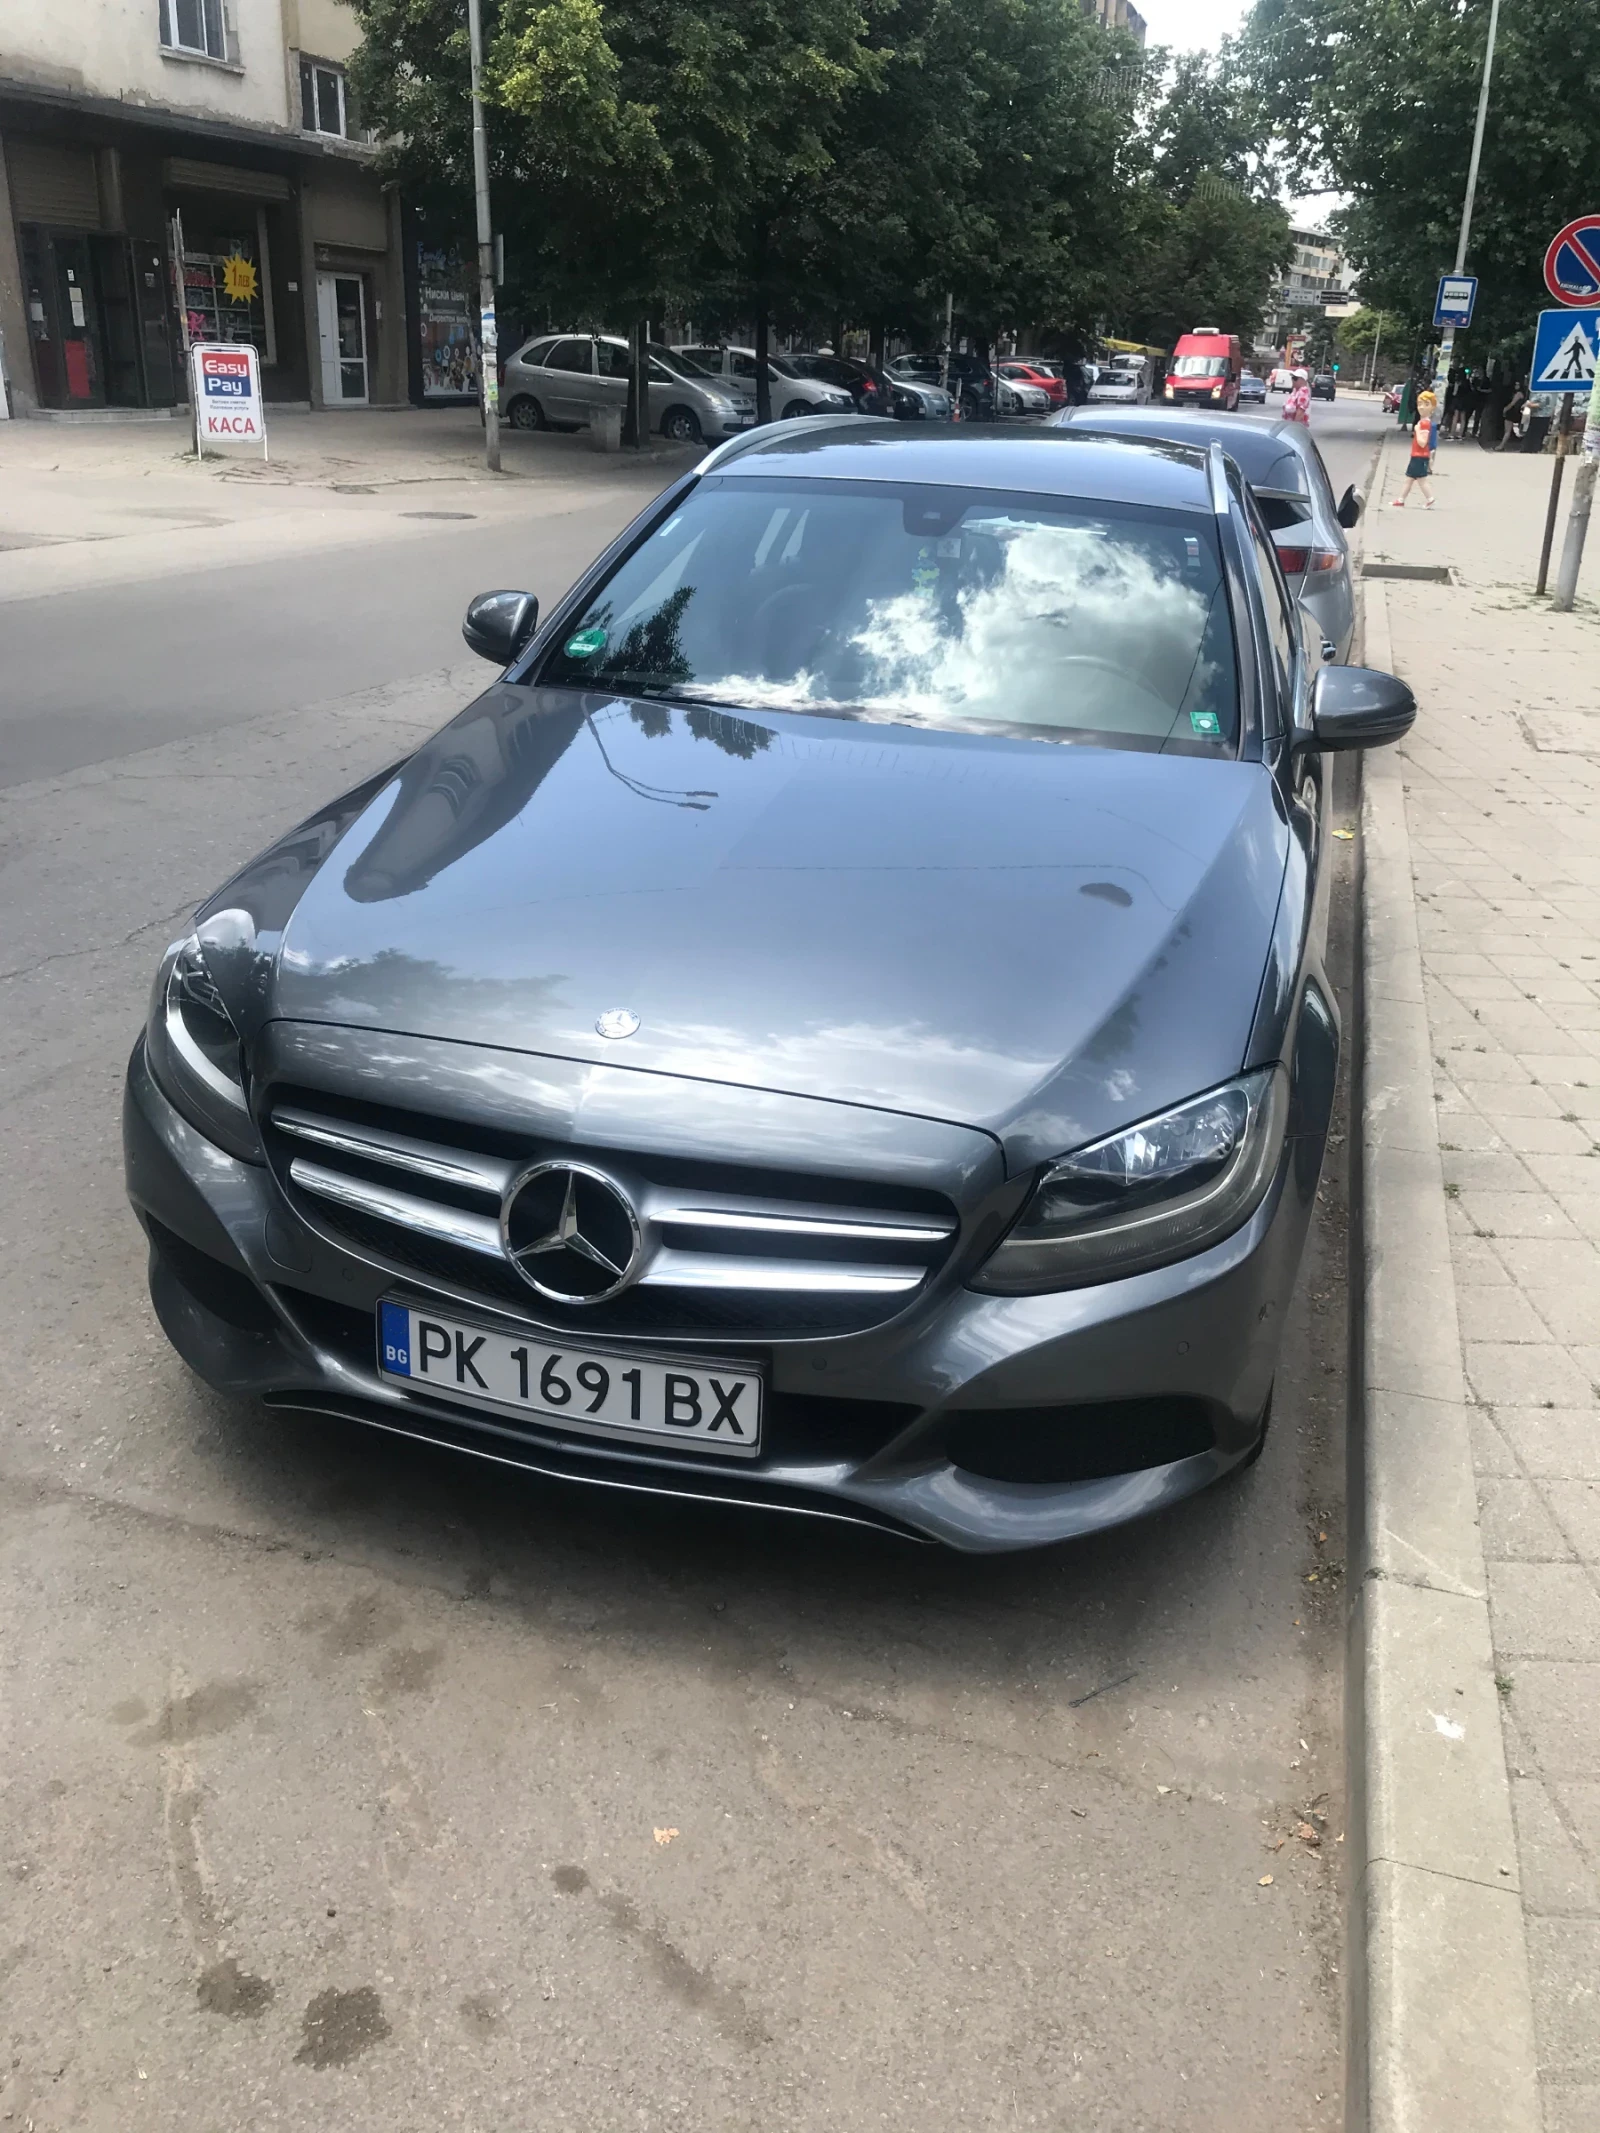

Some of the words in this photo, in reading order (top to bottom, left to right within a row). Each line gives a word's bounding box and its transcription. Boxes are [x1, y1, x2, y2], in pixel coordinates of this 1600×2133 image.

[232, 265, 237, 286] 1
[425, 287, 450, 300] Ниски
[205, 360, 247, 377] Easy
[208, 378, 242, 395] Pay
[208, 416, 256, 434] КАСА
[386, 1344, 407, 1364] BG
[418, 1320, 490, 1390] PK
[510, 1346, 642, 1421] 1691
[664, 1373, 746, 1435] BX
